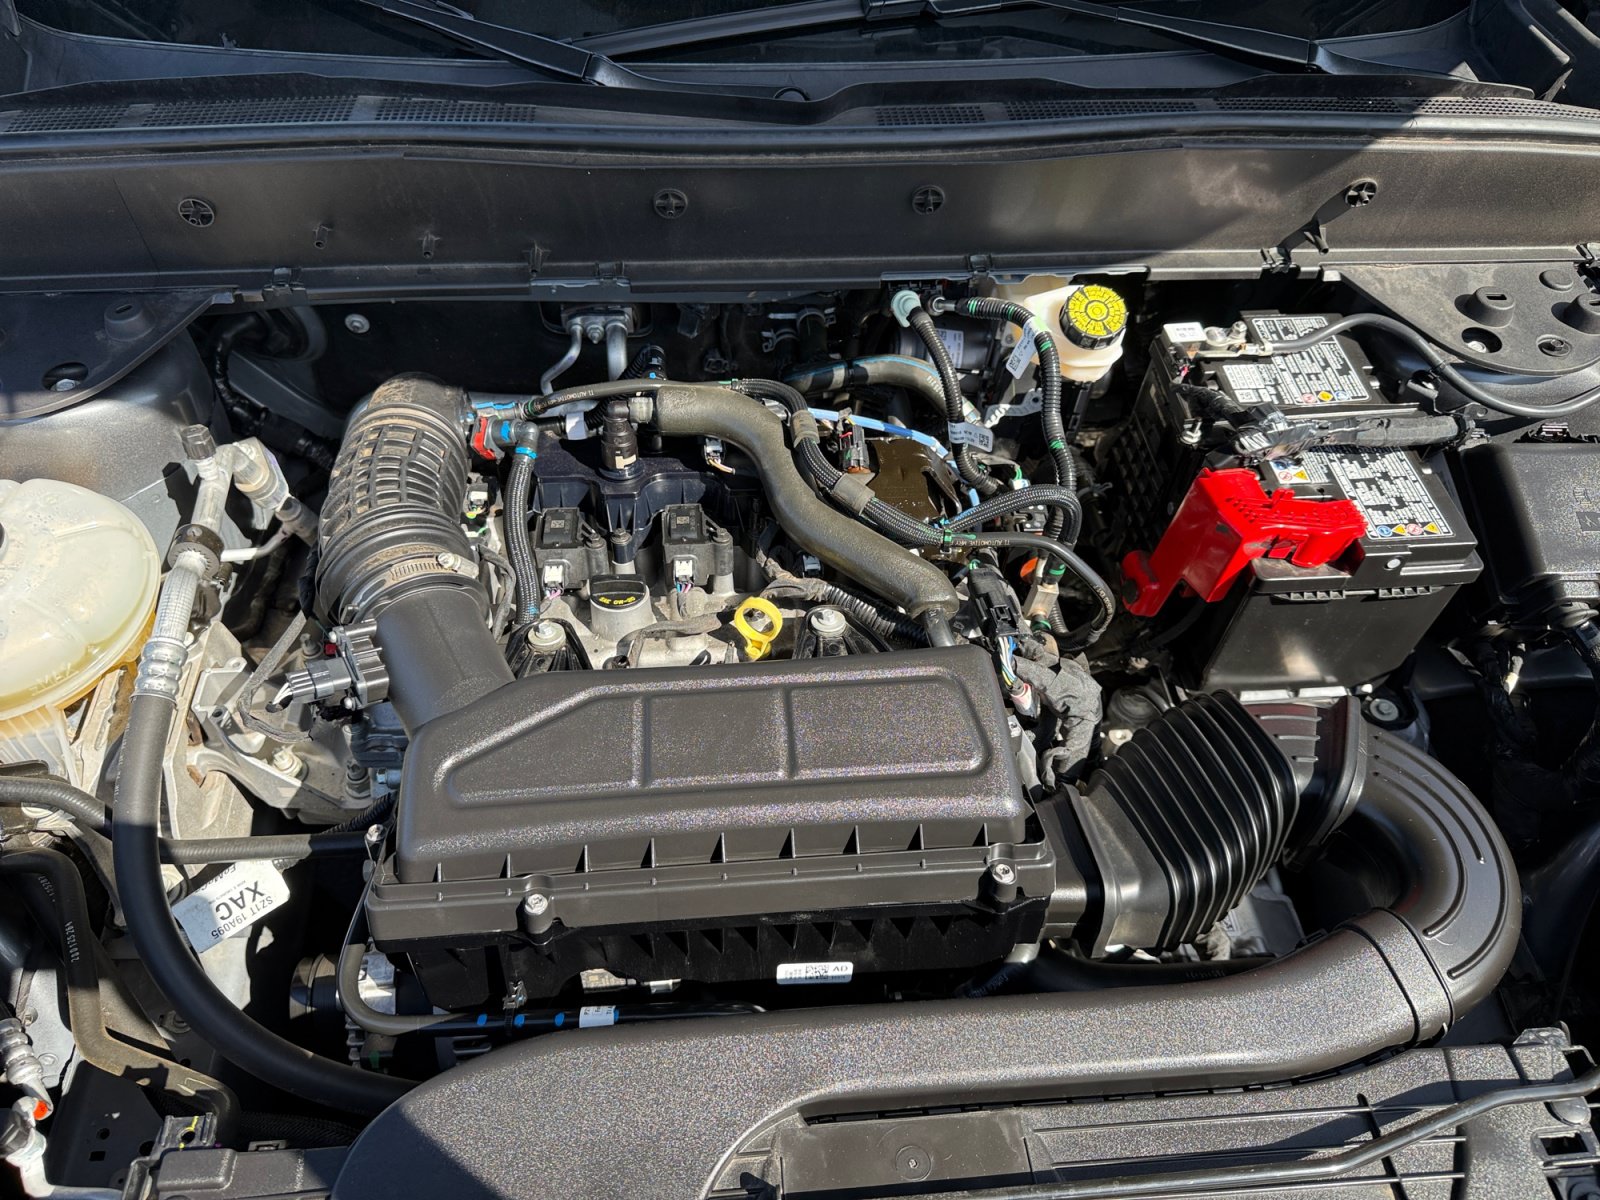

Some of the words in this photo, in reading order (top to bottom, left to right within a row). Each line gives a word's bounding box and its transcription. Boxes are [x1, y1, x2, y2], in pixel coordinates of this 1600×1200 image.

[215, 881, 265, 921] XAC
[250, 896, 273, 916] SZ1T
[211, 913, 247, 939] 19A095
